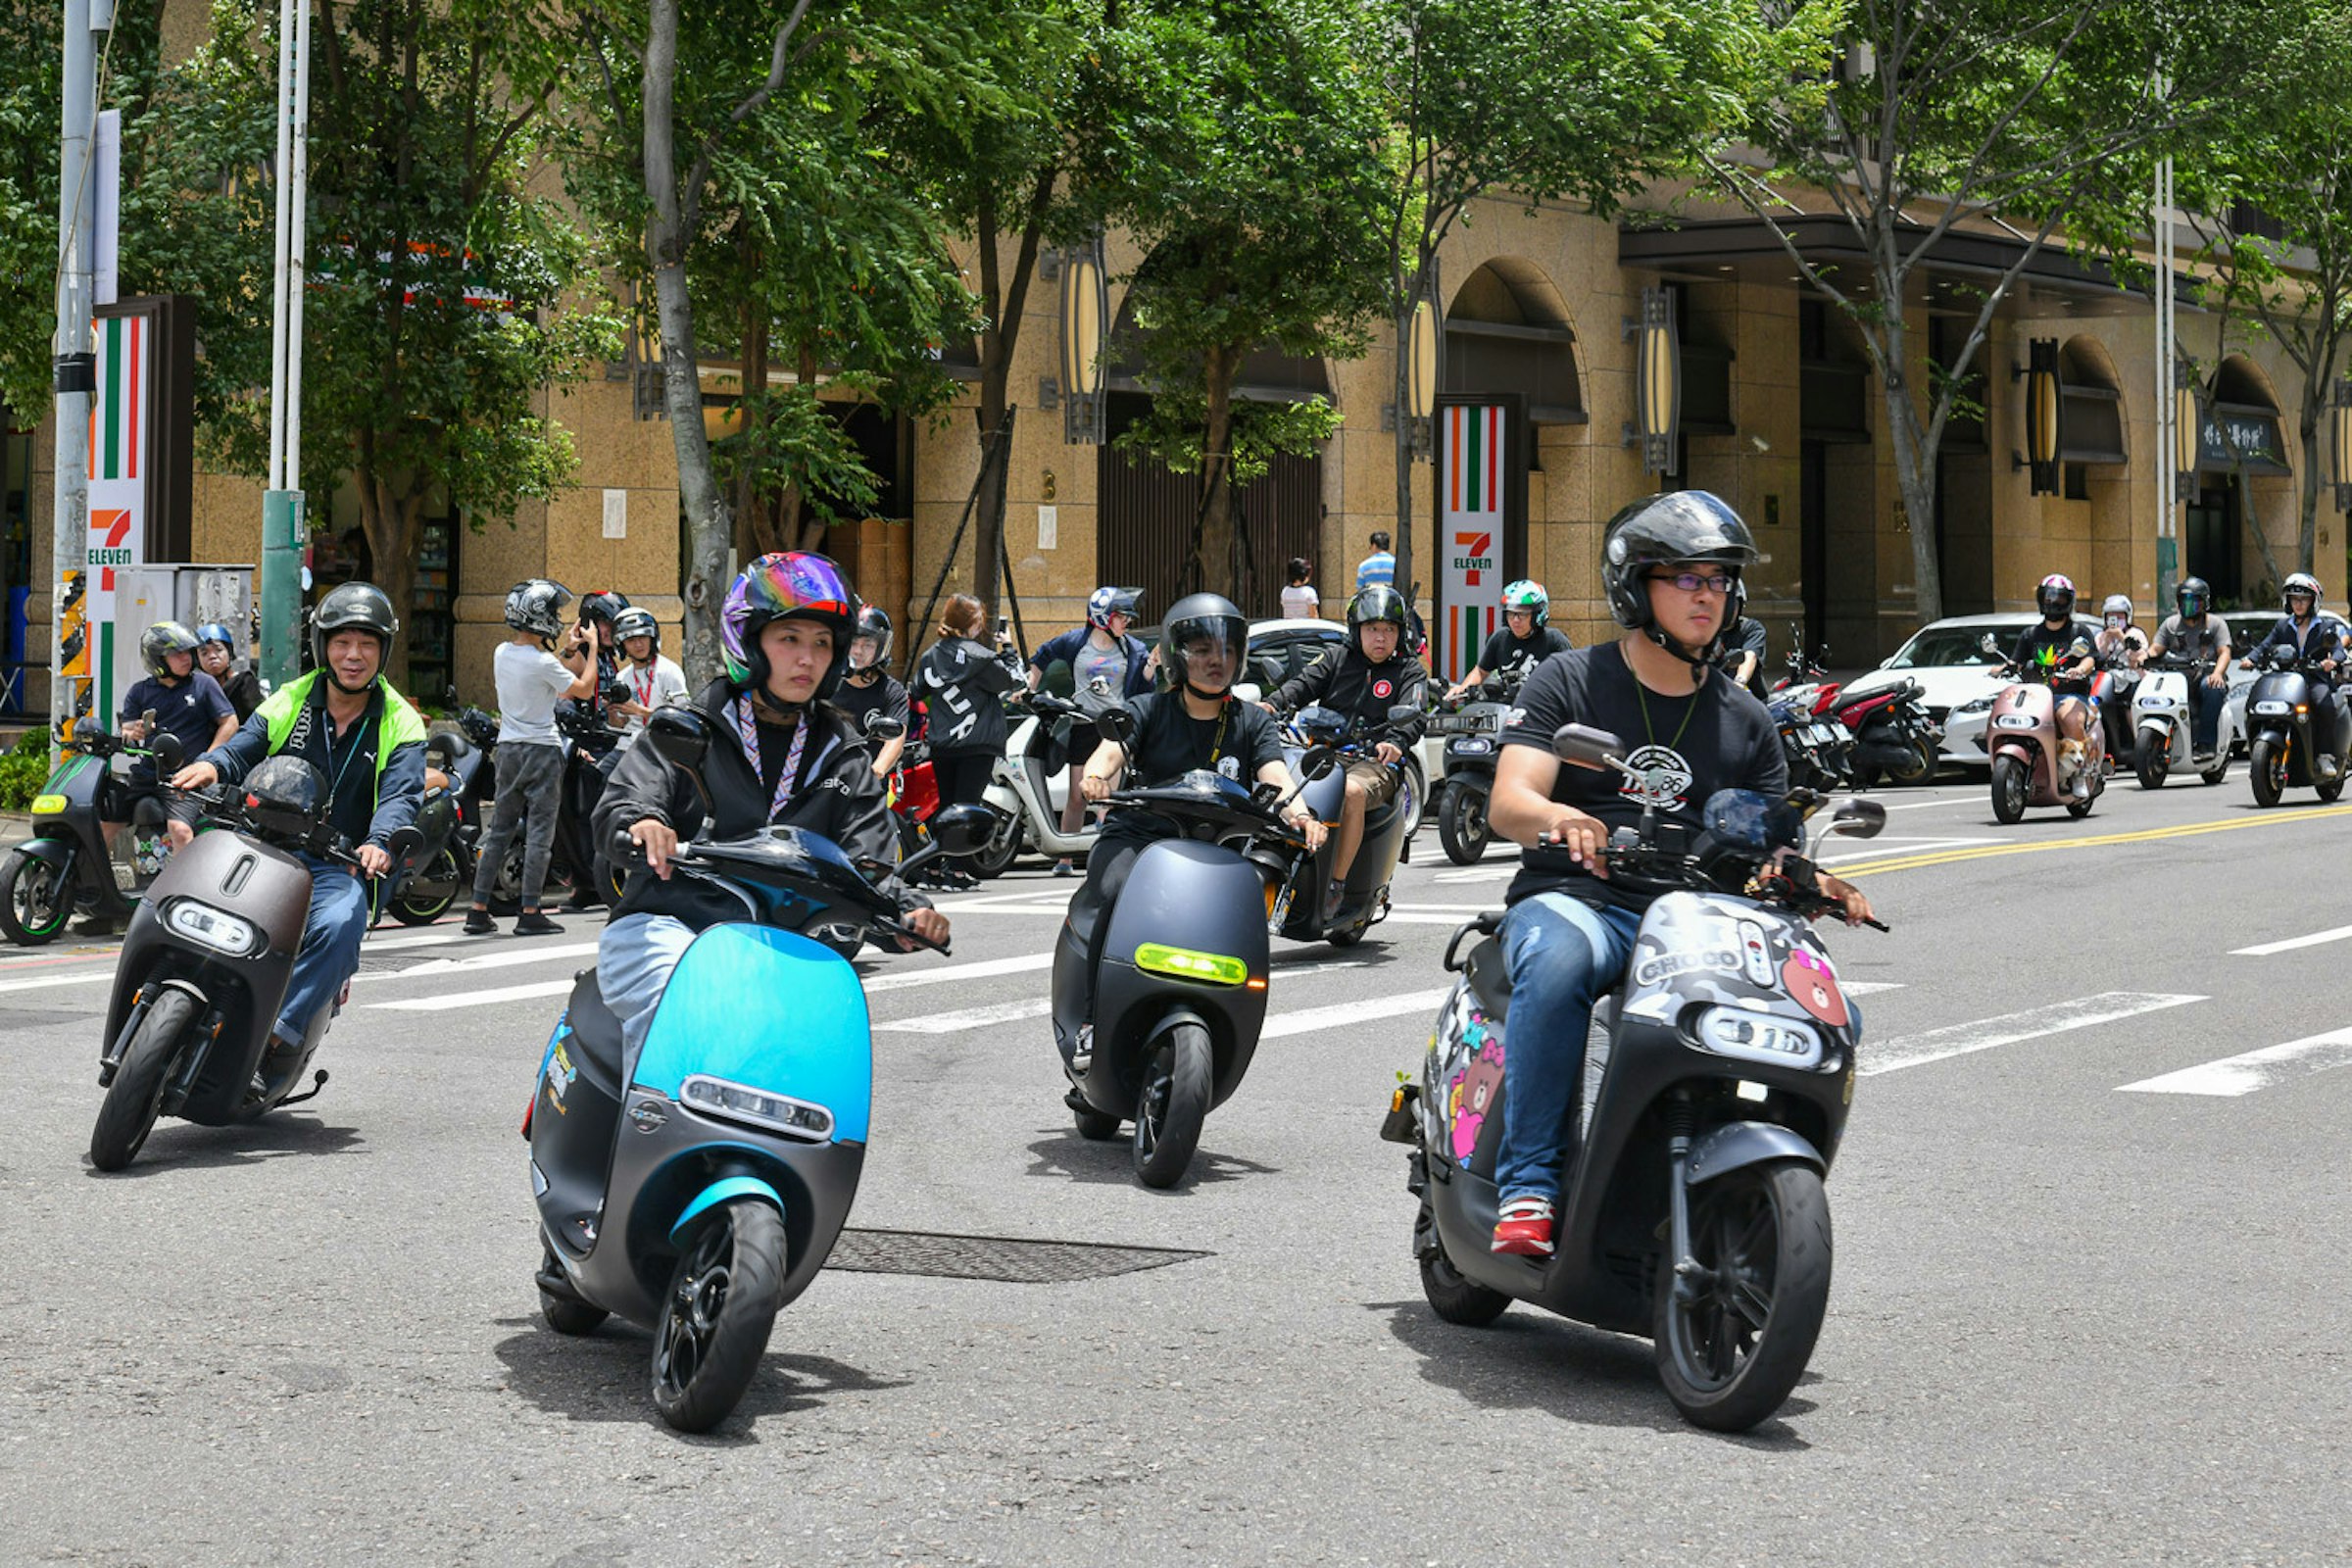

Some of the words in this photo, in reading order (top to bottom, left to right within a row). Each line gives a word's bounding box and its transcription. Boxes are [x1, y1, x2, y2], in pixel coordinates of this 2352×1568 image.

[90, 510, 130, 591] 7
[1455, 532, 1491, 586] 7
[1641, 949, 1739, 982] CHOCO
